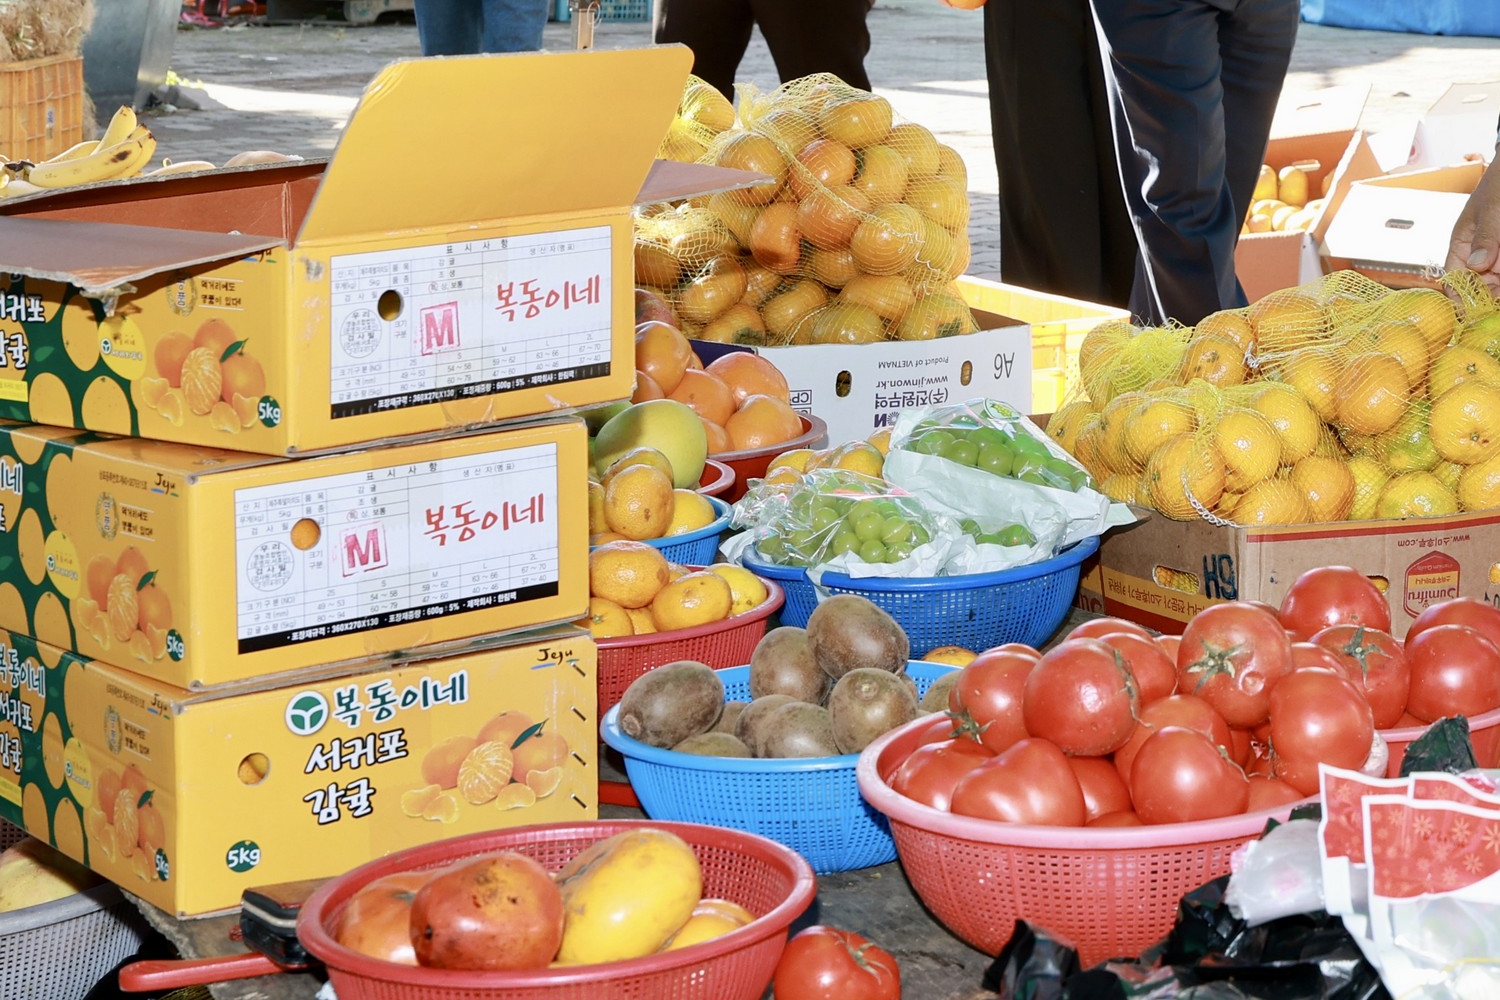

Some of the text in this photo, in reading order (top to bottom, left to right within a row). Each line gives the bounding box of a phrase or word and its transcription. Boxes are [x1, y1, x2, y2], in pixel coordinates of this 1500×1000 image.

[495, 274, 600, 322] 복동이네
[425, 308, 454, 349] M
[878, 356, 949, 369] Product of VIETNAM
[993, 352, 1015, 380] A6
[875, 375, 949, 390] www.jinwon.kr
[874, 387, 949, 410] (주)진원무역
[259, 402, 281, 424] 5kg
[423, 493, 544, 546] 복동이네
[344, 528, 381, 569] M
[1128, 586, 1162, 608] 스미후루가
[1164, 595, 1185, 614] 전문가
[166, 638, 185, 659] 5kg
[537, 648, 574, 665] Jeju
[333, 671, 468, 728] 복동이네
[305, 729, 408, 773] 서귀포
[303, 778, 376, 824] 감귤
[155, 853, 169, 878] 5kg
[227, 845, 262, 872] 5kg
